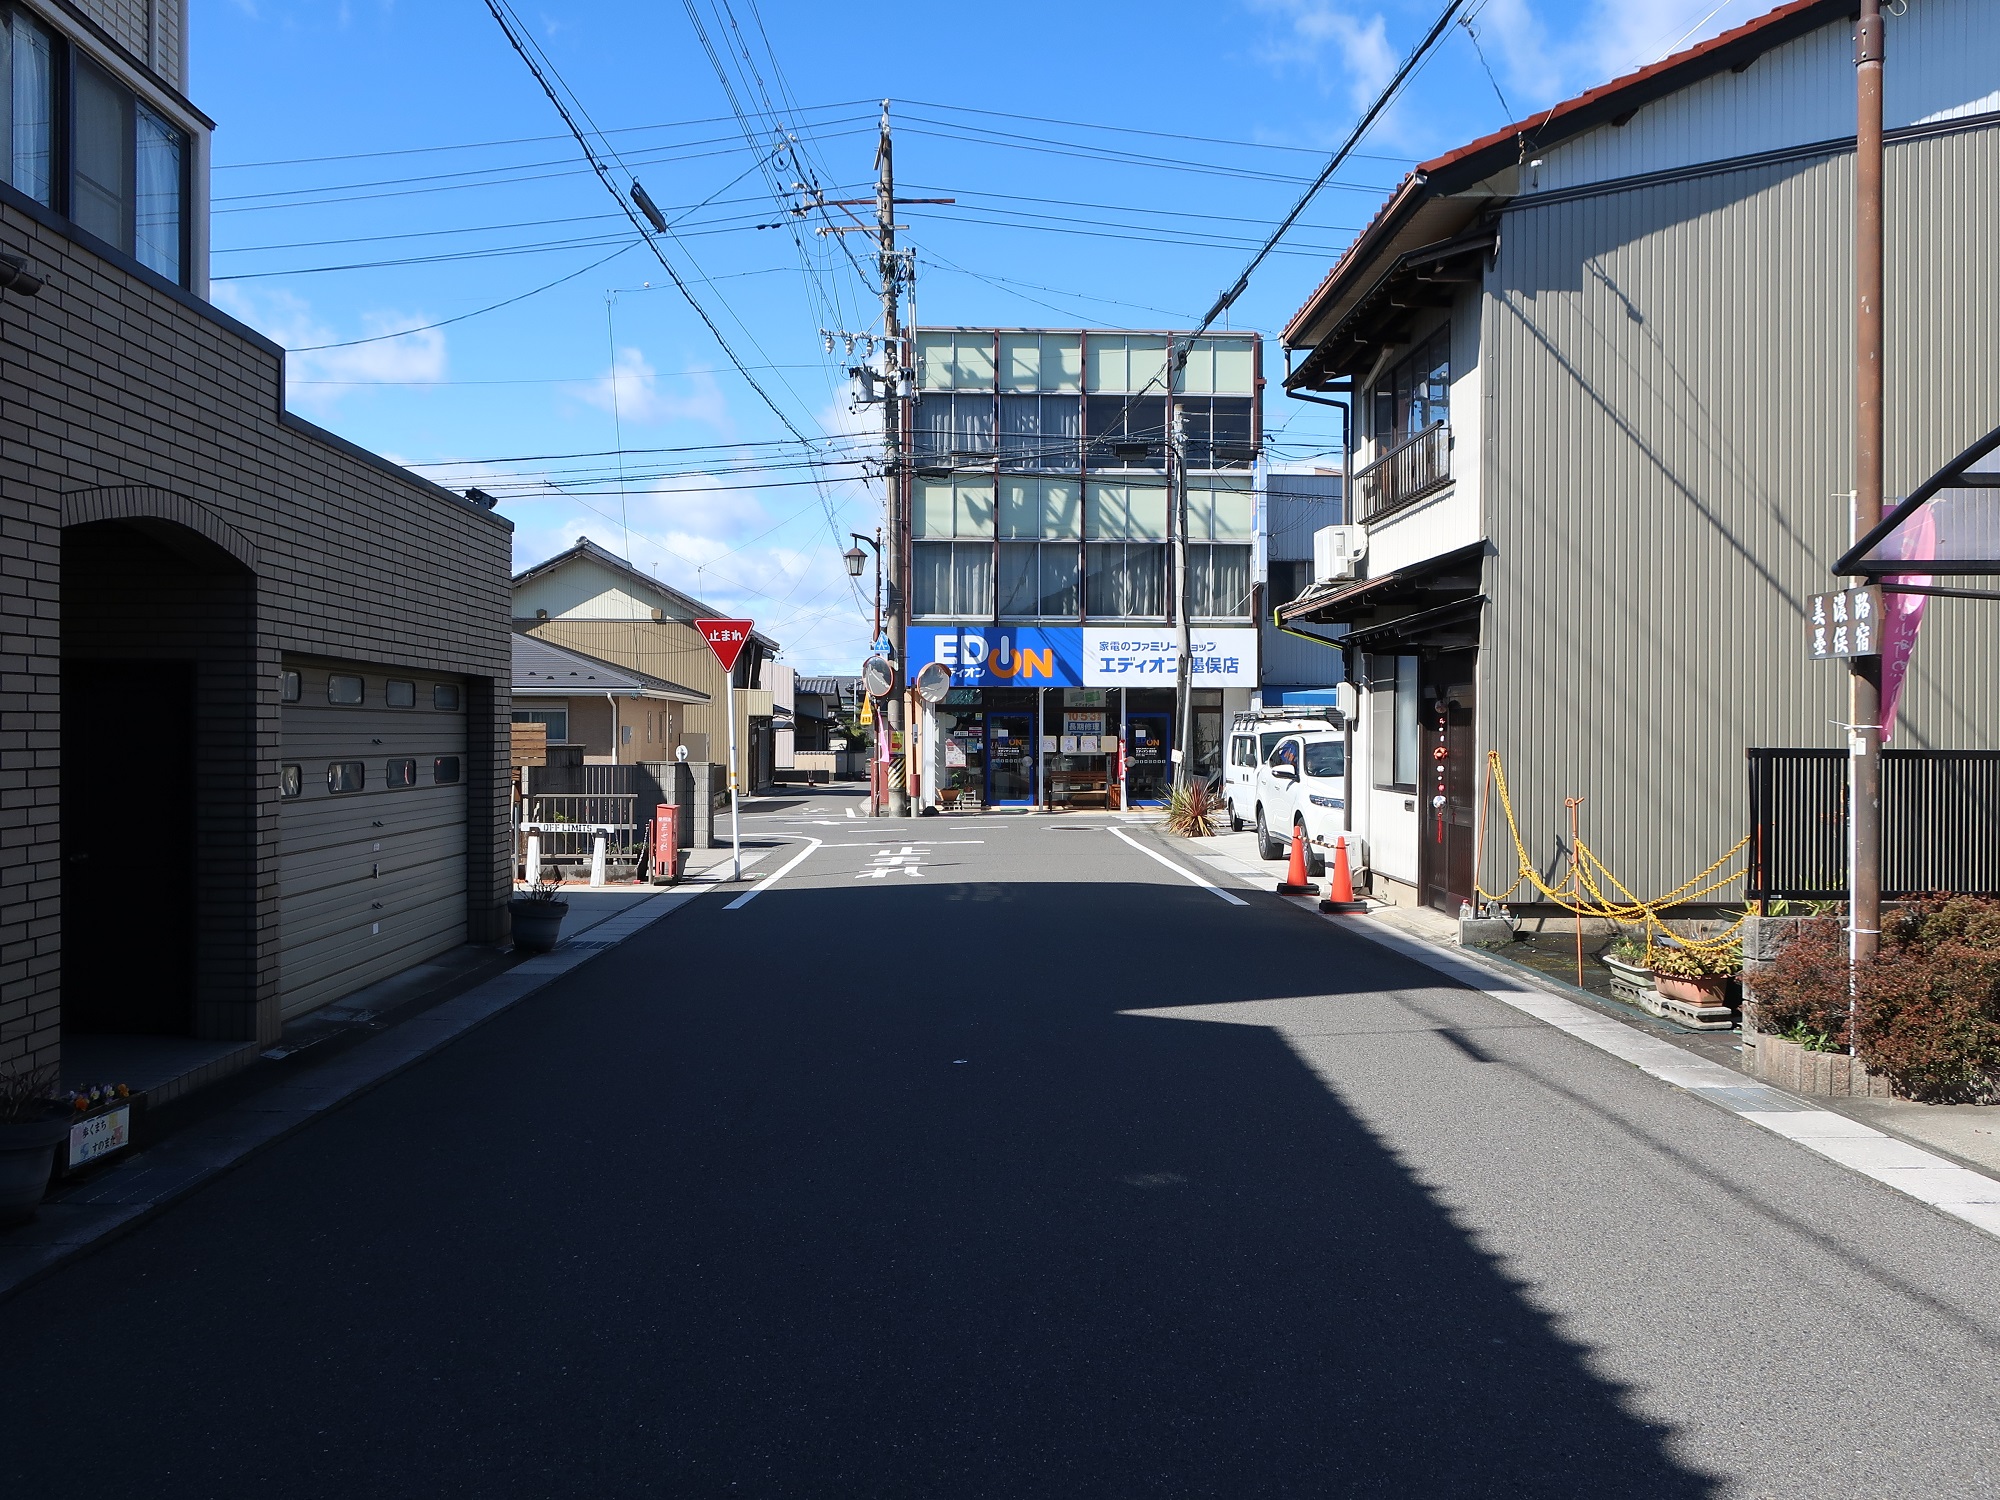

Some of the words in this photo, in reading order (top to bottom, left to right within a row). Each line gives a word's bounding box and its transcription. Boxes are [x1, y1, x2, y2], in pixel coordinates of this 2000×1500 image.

[1812, 591, 1871, 625] 美濃路
[708, 629, 743, 642] 止まれ
[1099, 641, 1217, 652] 家電のファミリーョップ
[934, 634, 1053, 678] EDION
[543, 823, 560, 832] OFF
[562, 824, 593, 833] LIMITS
